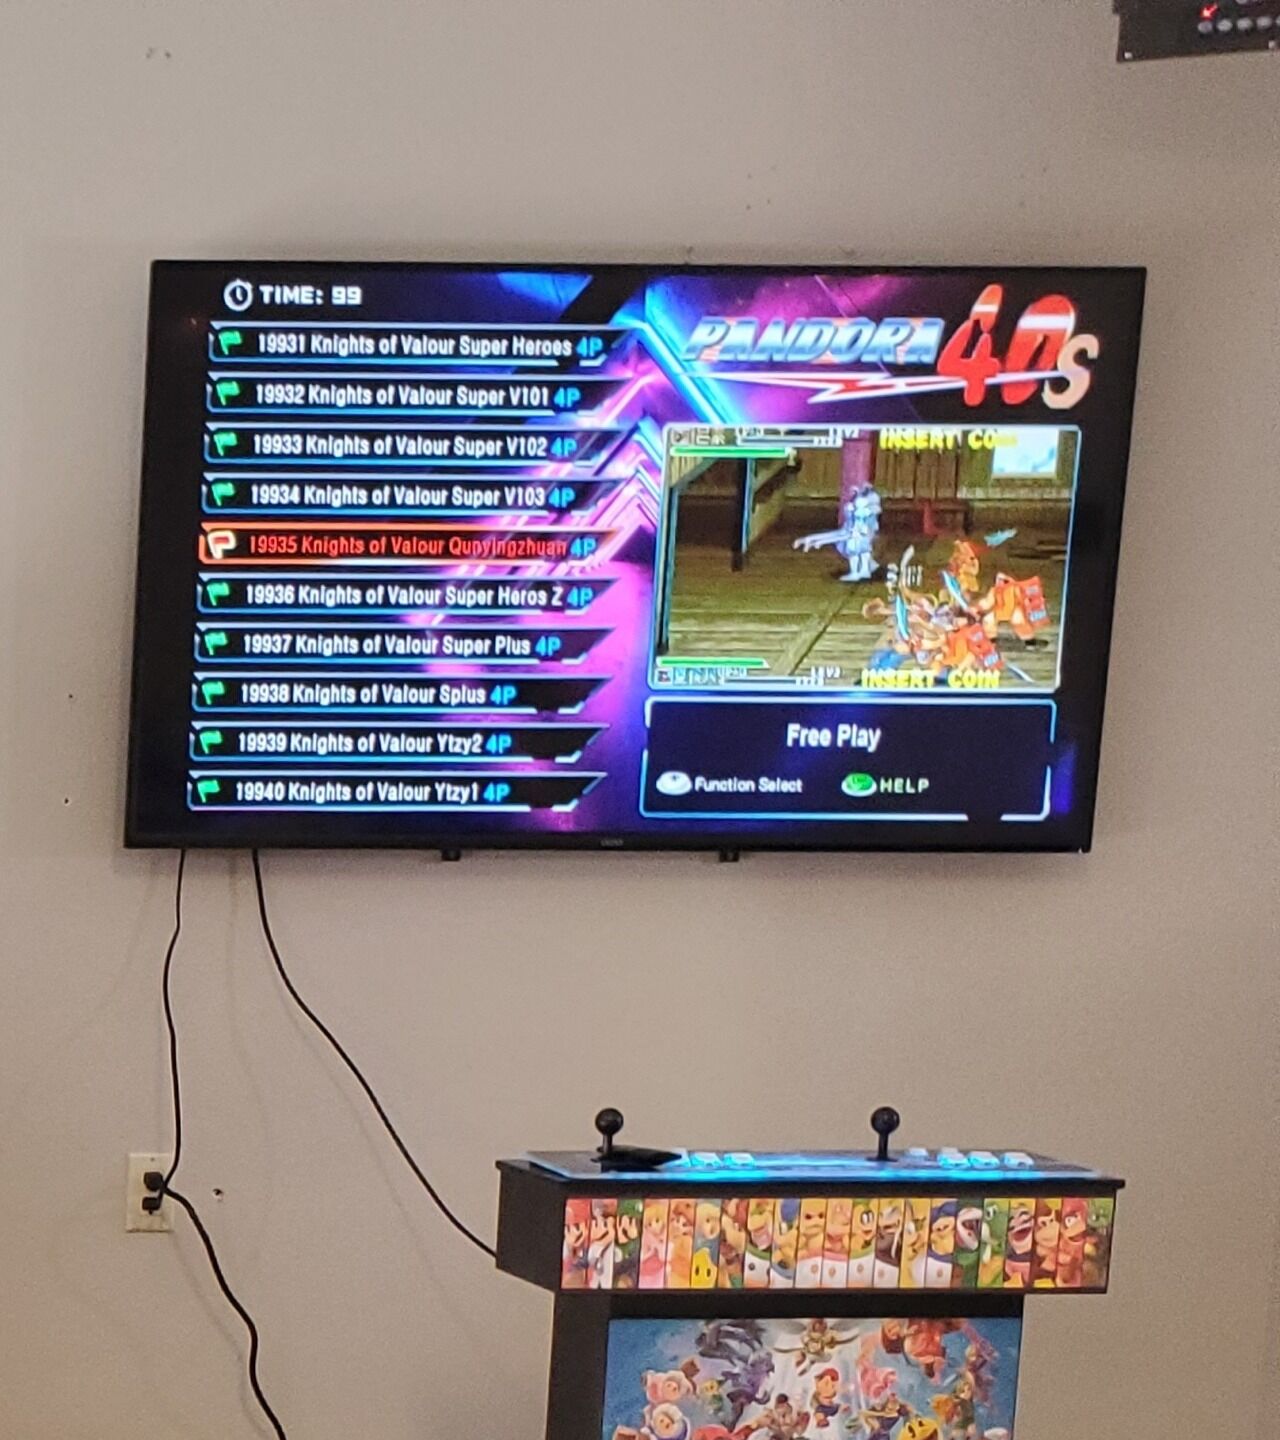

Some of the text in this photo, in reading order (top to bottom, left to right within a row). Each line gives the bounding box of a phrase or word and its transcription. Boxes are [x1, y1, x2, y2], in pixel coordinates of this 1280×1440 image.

[259, 286, 362, 304] TIME: 99
[258, 334, 603, 358] 19931 Knights of Valour Super Heroes 4P
[683, 317, 945, 365] PANDORA
[256, 384, 581, 408] 19932 Knights of Valour Super V101 4P
[253, 434, 577, 458] 19933 Knights of Valour Super V102 4P
[879, 427, 955, 450] INSERT
[967, 428, 1017, 450] CO
[251, 485, 575, 508] 19934 Knights of Valour Super V103 4P
[249, 536, 297, 554] 19935
[301, 536, 365, 558] Knights
[369, 537, 387, 555] of
[391, 537, 444, 556] Valour
[570, 538, 596, 557] 4P
[247, 585, 594, 607] 19936 Knights of Valour Super Heros Z 4P
[244, 634, 562, 658] 19937 Knights of Valour Super Plus 4P
[861, 667, 935, 688] INSERT
[947, 669, 1000, 688] COIN
[241, 684, 289, 703] 19938
[293, 684, 356, 706] Knights
[361, 685, 379, 704] of
[382, 685, 436, 704] Valour
[490, 686, 517, 704] 4P
[239, 733, 512, 756] 19939 Knights of Valour Ytzy2 4P
[787, 723, 881, 752] Free Play
[236, 783, 284, 802] 19940
[288, 782, 351, 804] Knights
[355, 783, 374, 802] of
[377, 783, 430, 802] Valour
[483, 784, 510, 802] 4P
[694, 776, 803, 793] Function Select
[880, 778, 929, 794] HELP
